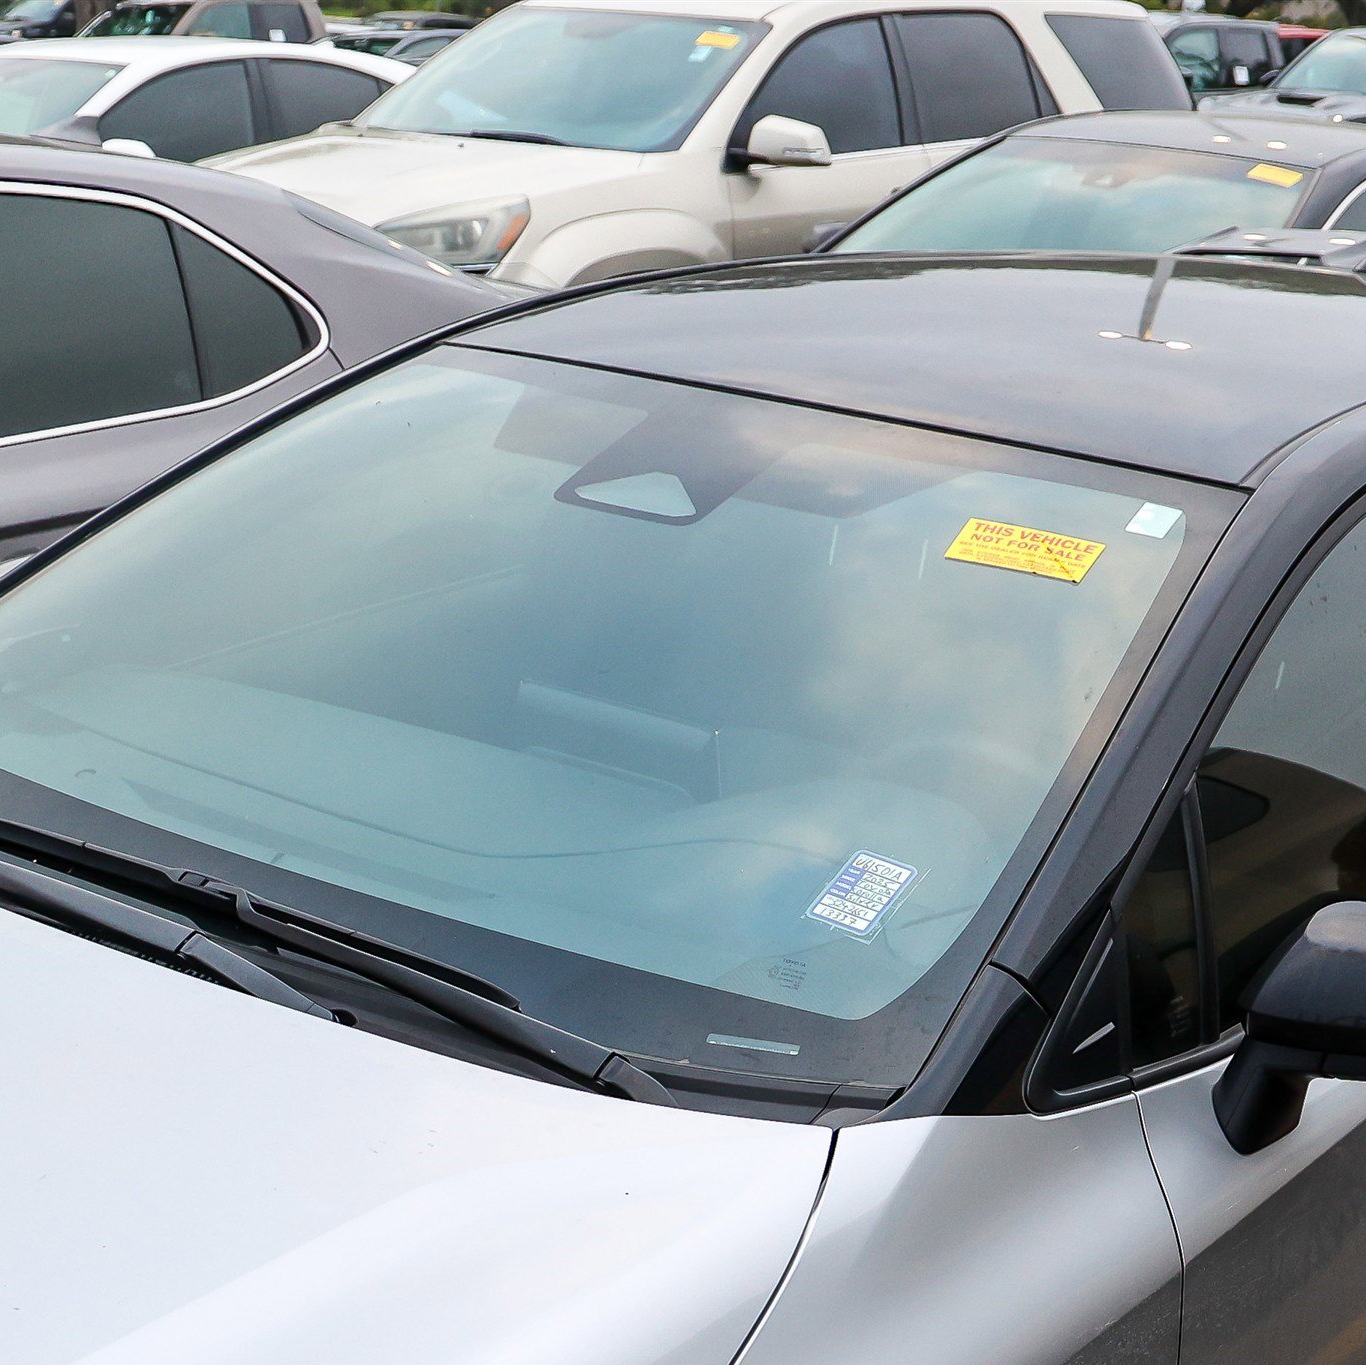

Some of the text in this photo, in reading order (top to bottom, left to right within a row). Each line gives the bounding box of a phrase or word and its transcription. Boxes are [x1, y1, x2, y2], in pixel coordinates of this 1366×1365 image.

[971, 533, 1004, 544] NOT
[1006, 540, 1040, 551] FOR
[1045, 547, 1086, 561] SALE
[975, 522, 1098, 555] THIS VEHICLE
